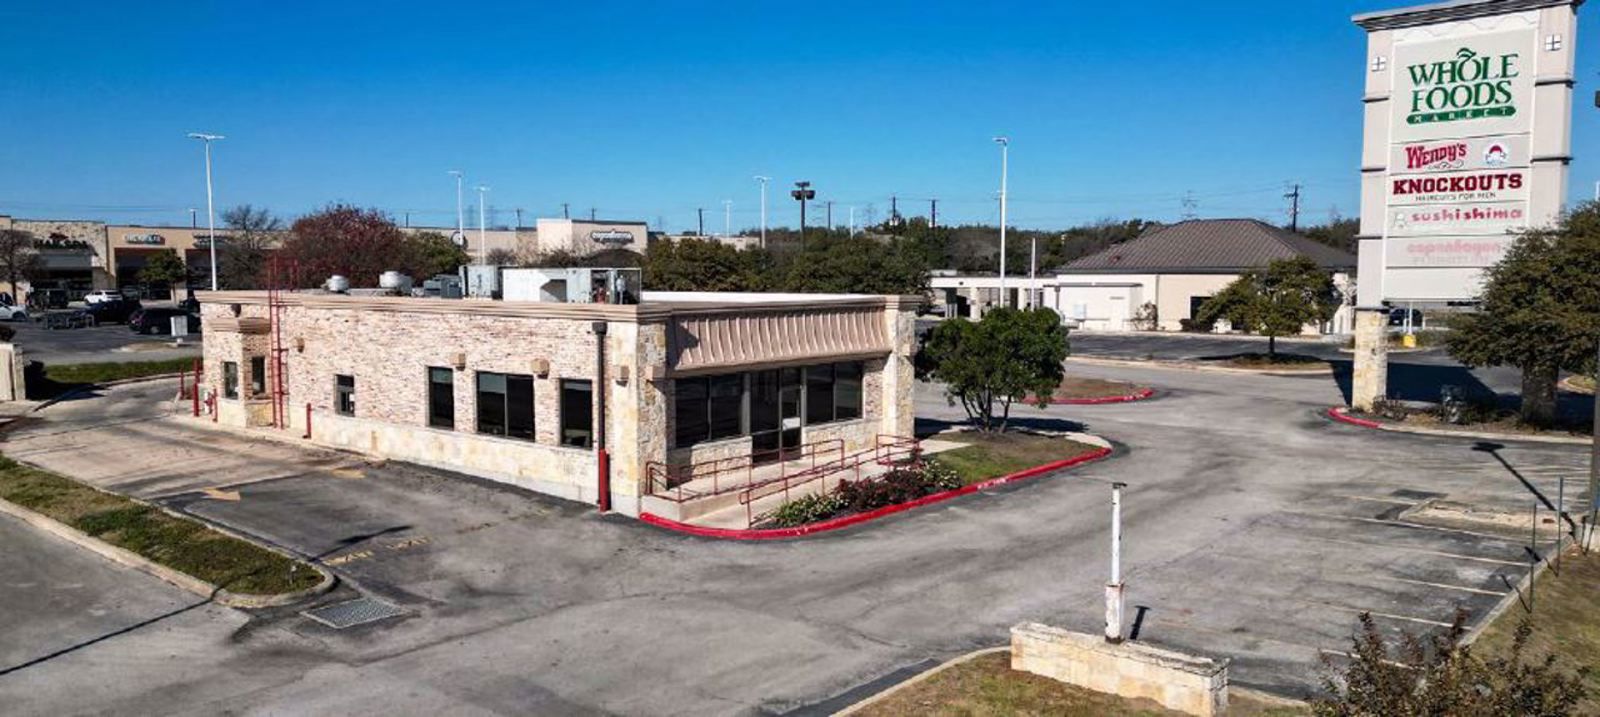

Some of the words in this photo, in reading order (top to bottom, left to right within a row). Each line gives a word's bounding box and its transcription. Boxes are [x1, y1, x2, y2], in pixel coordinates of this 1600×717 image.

[1406, 48, 1519, 87] WHOLE
[1411, 80, 1512, 112] FOODS
[1414, 106, 1507, 122] MARKET
[1405, 143, 1467, 169] Wendy's
[1393, 173, 1522, 195] KNOCKOUTS
[1415, 193, 1457, 201] HAIRCUTS
[1458, 192, 1476, 200] FOR
[1477, 191, 1496, 199] MEN
[1412, 207, 1523, 222] sushishima
